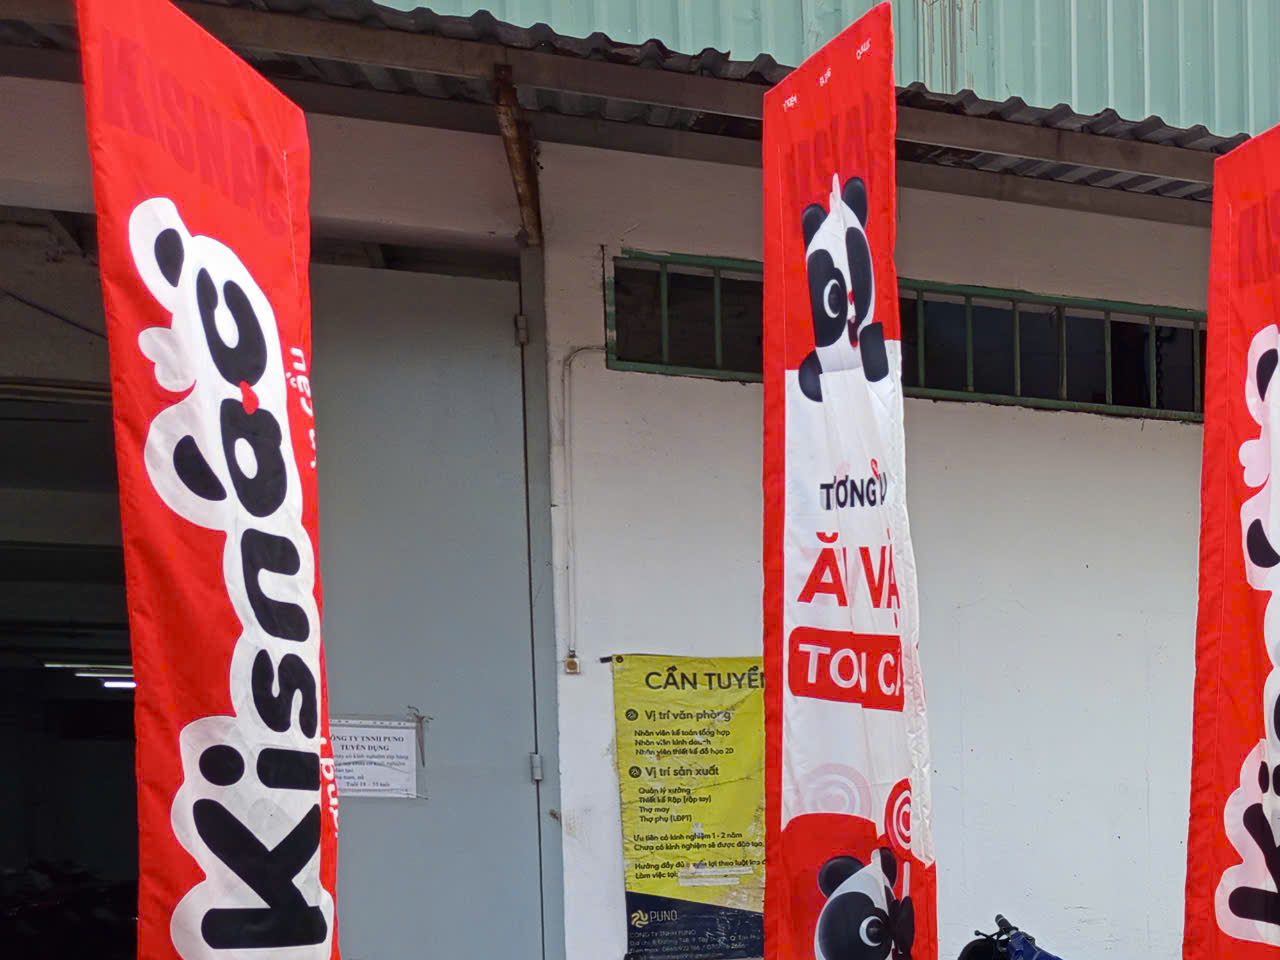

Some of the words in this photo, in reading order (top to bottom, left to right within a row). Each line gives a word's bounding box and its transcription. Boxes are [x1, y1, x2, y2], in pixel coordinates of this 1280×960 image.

[644, 710, 656, 722] Vị
[659, 710, 671, 719] trí
[671, 710, 693, 719] văn
[645, 767, 657, 778] Vị
[659, 767, 671, 776] trí
[673, 766, 692, 776] sản
[695, 764, 719, 776] xuất
[650, 910, 678, 921] PUNO
